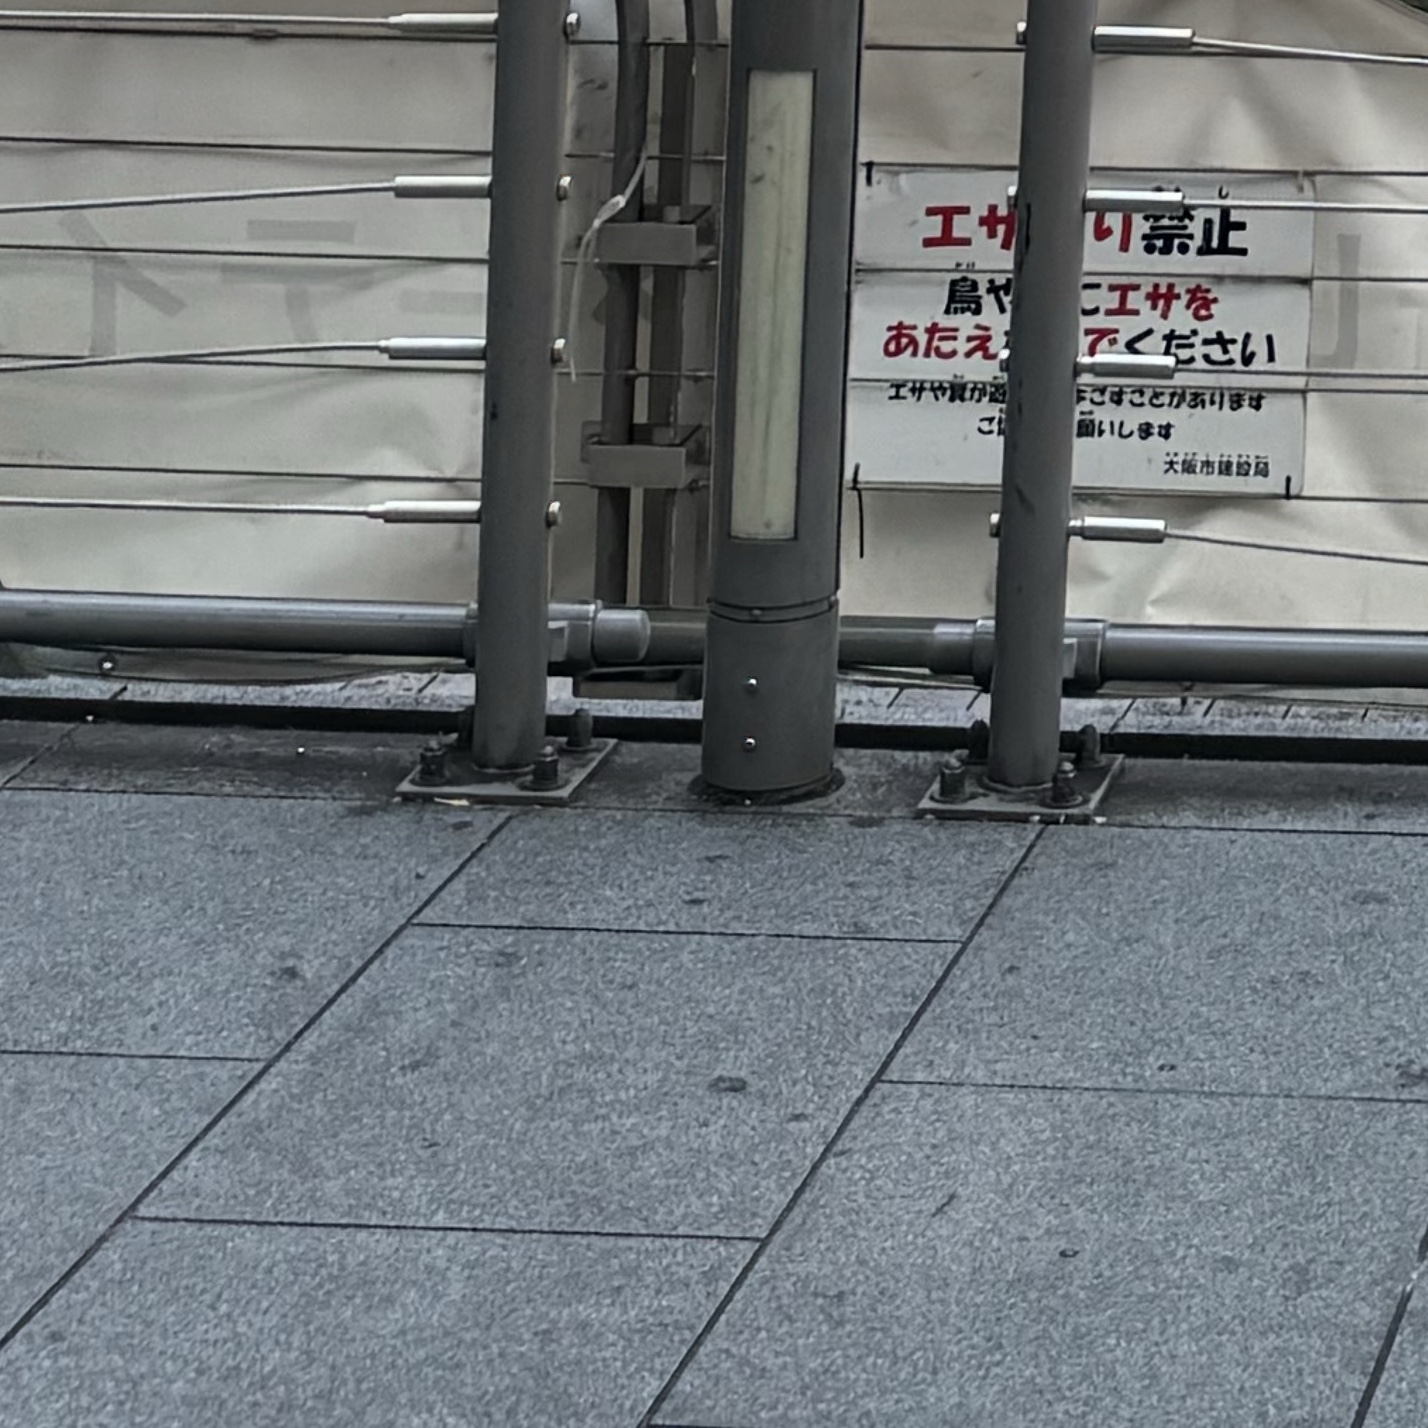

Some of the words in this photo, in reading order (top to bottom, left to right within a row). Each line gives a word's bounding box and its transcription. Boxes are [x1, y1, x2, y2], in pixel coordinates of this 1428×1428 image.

[922, 202, 1249, 257] エサり禁止
[943, 275, 1219, 322] 鳥やにエサを
[882, 320, 1276, 368] あたえでください
[1163, 458, 1270, 478] 大阪市建設局
